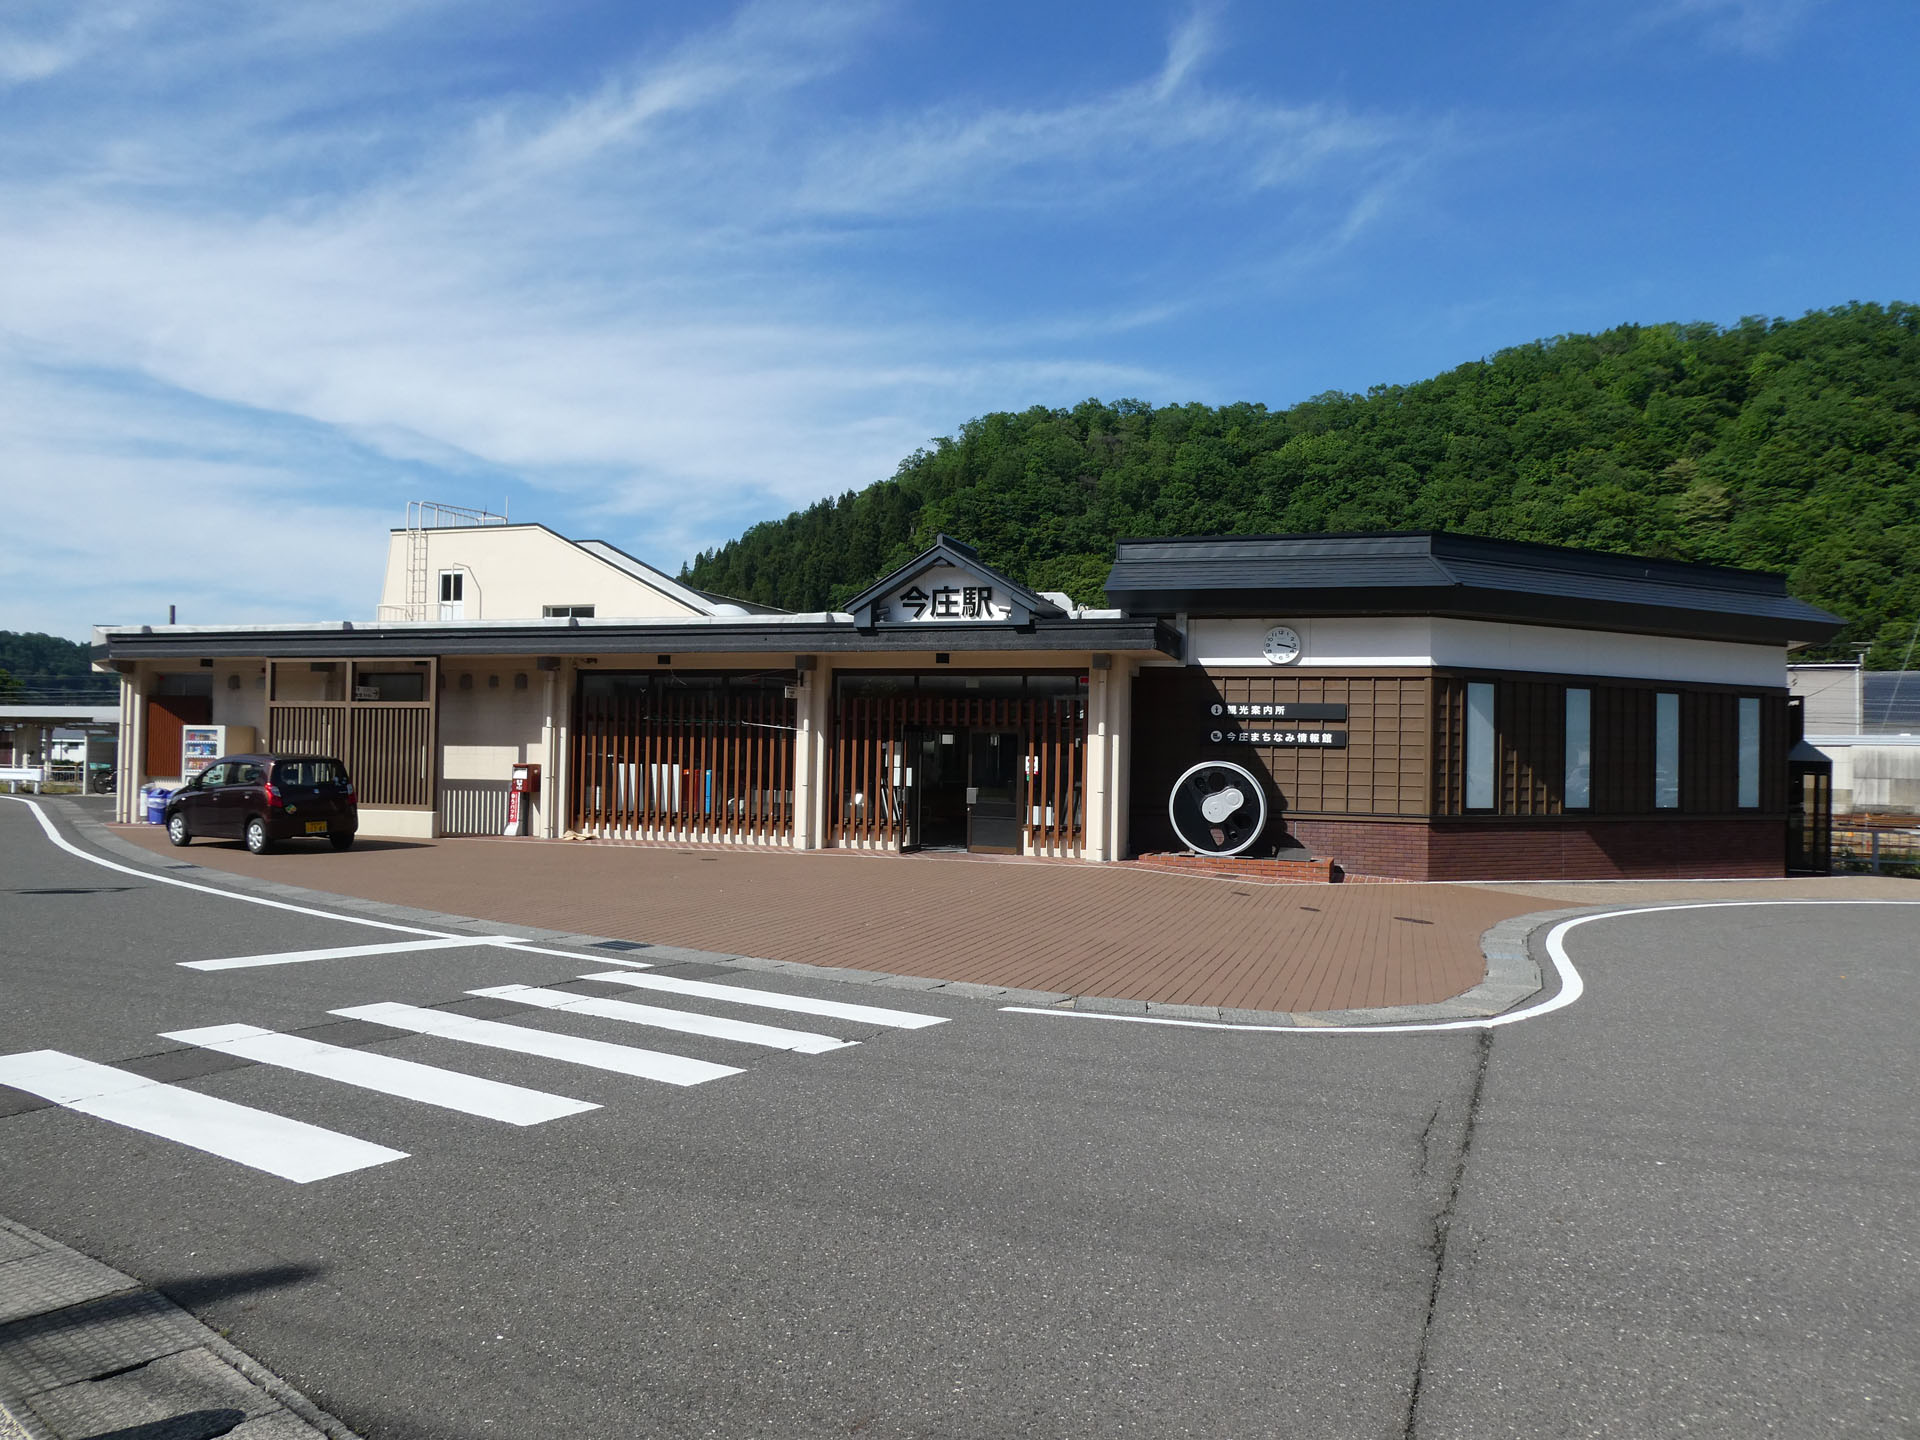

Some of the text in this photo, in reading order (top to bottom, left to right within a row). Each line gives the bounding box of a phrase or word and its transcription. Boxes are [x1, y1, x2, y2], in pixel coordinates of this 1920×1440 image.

[899, 586, 994, 618] 今庄駅
[1227, 705, 1286, 715] 観光案内所
[1226, 731, 1333, 744] 今庄まちなみ情報館
